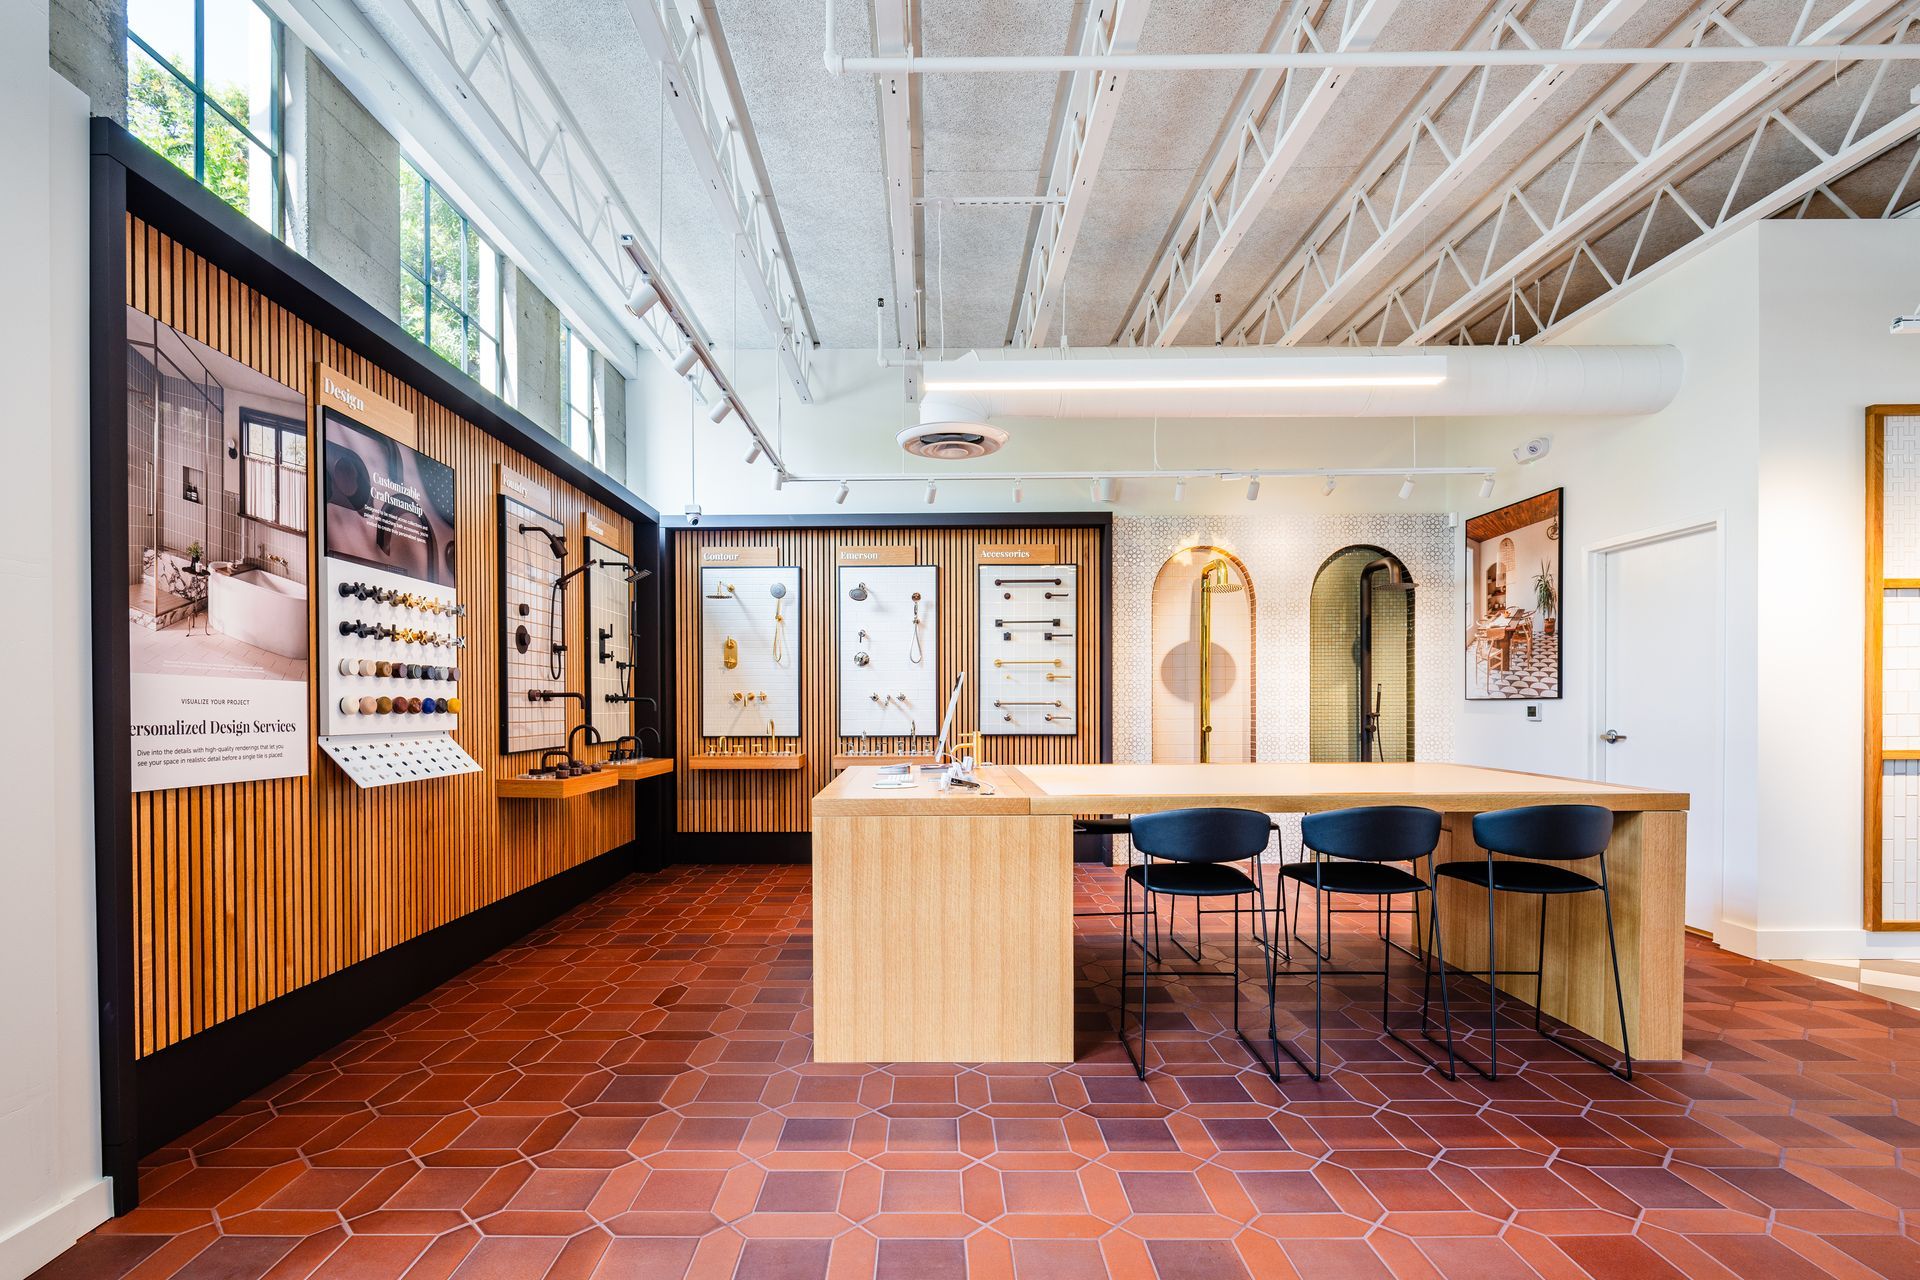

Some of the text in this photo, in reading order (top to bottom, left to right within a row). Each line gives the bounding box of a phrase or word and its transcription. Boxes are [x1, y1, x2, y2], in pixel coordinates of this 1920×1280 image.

[324, 375, 364, 412] Design
[373, 472, 421, 501] Customizable
[370, 487, 423, 517] Craftsmanship
[703, 552, 739, 562] Contour
[840, 551, 878, 560] Emerson
[981, 549, 1030, 558] Accessories
[131, 719, 296, 737] ersonalized Design Services
[205, 745, 234, 754] high-quality
[235, 744, 259, 752] renderings
[163, 758, 179, 766] space
